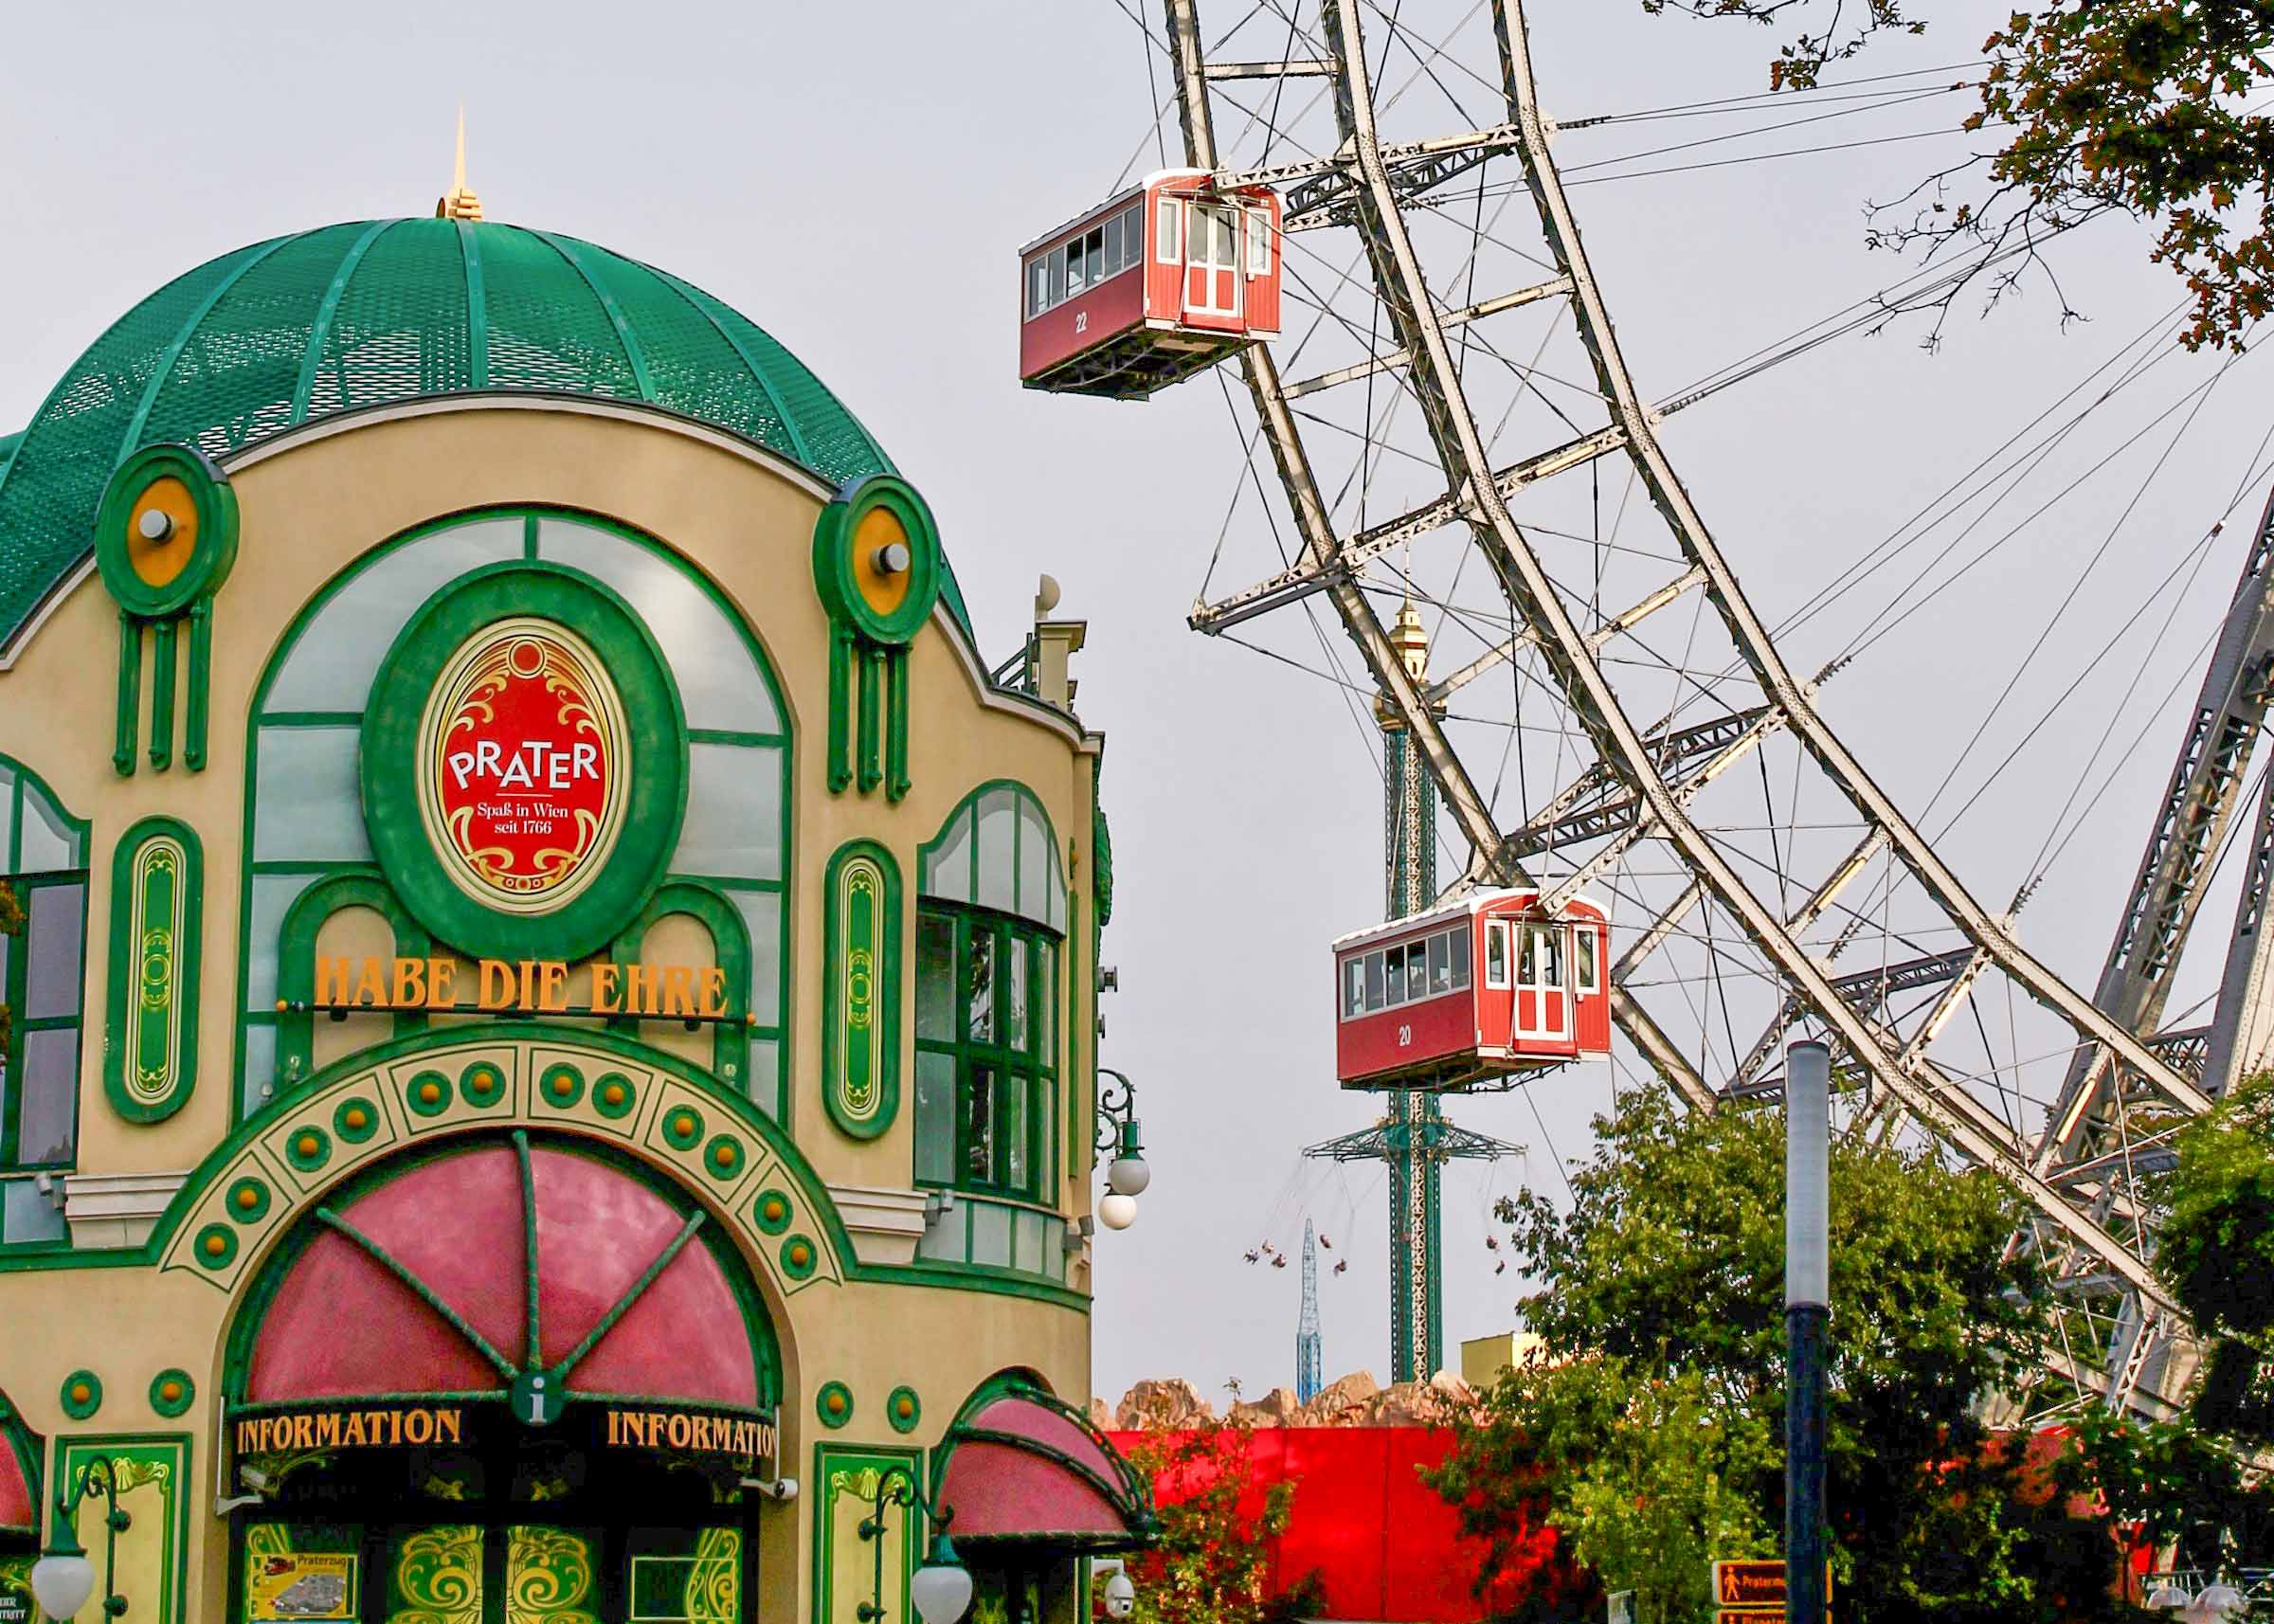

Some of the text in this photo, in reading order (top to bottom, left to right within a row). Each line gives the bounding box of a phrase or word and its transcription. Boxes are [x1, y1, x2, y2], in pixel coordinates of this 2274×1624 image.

[1075, 311, 1088, 334] 22
[447, 740, 600, 790] PRATER
[477, 803, 568, 820] Spaß in Wien
[494, 820, 552, 834] seit 1766
[314, 955, 729, 1019] HABE DIE EHRE
[1398, 1024, 1412, 1047] 20
[528, 1377, 547, 1426] i
[237, 1408, 461, 1454] INFORMATION
